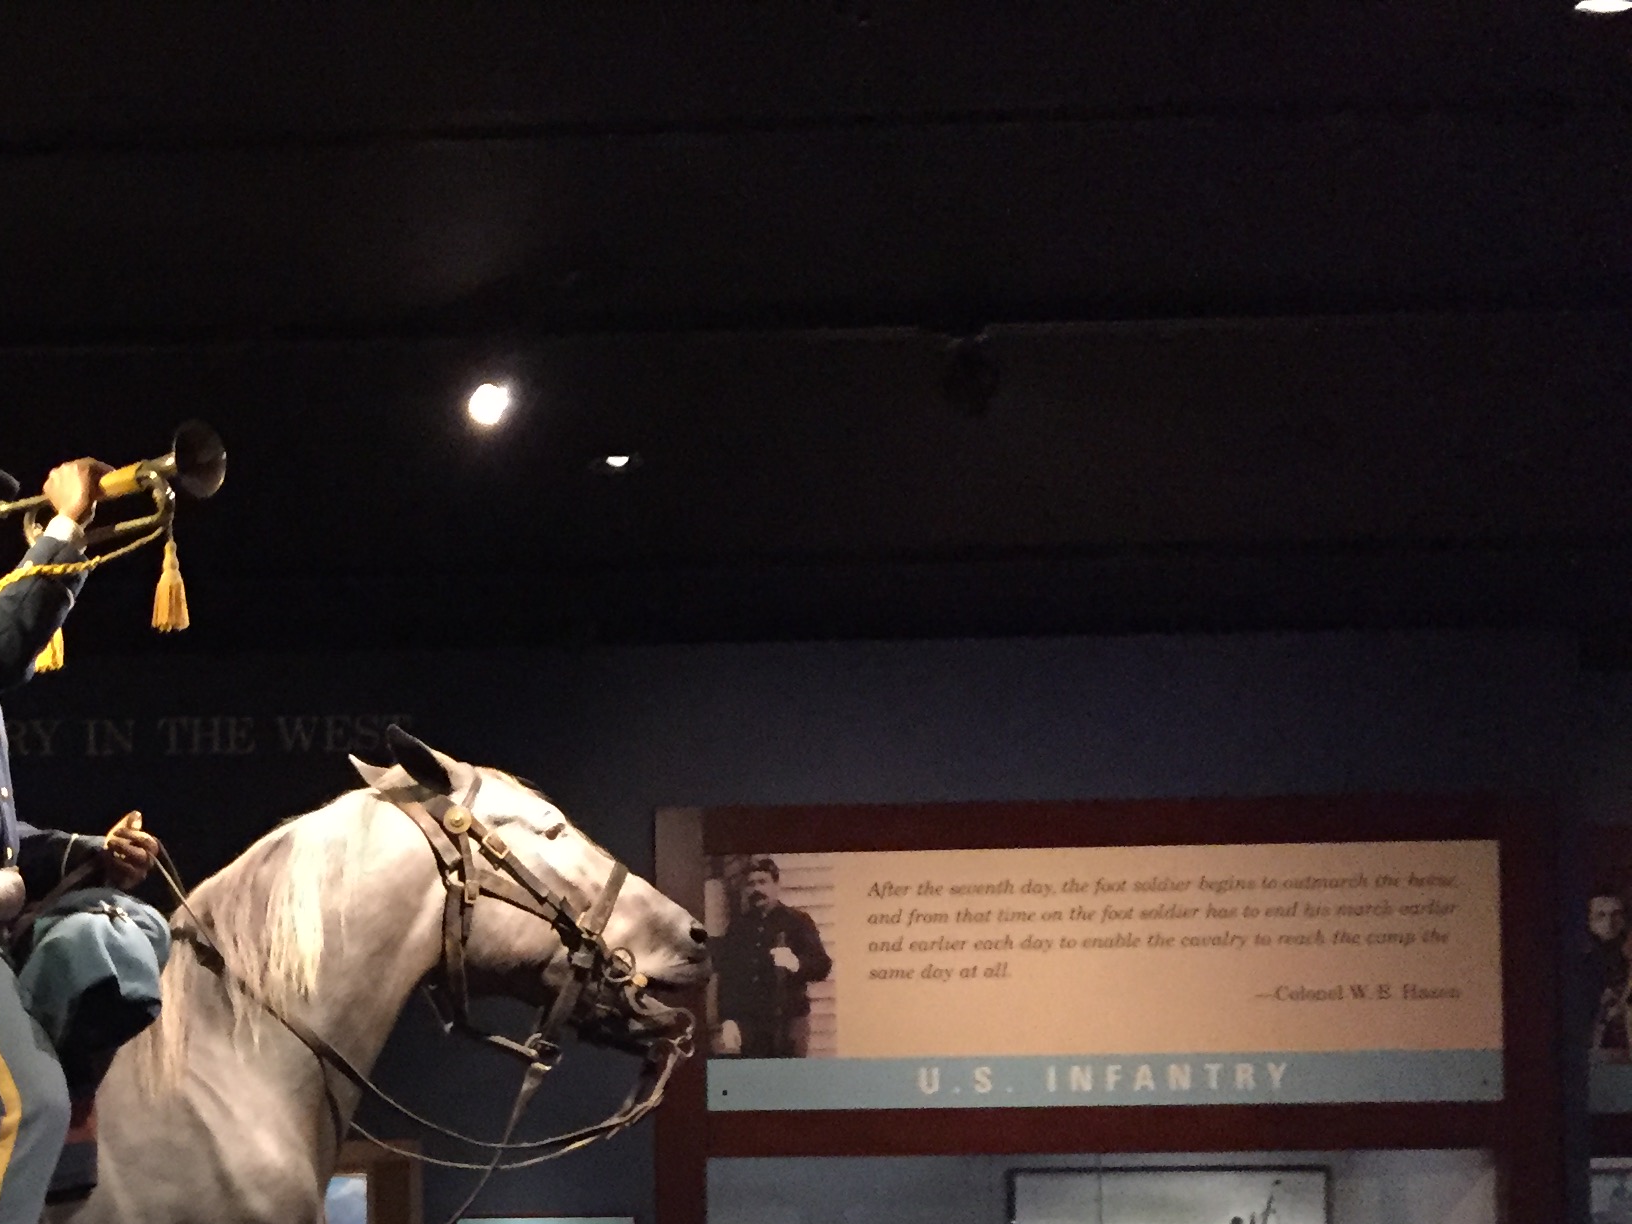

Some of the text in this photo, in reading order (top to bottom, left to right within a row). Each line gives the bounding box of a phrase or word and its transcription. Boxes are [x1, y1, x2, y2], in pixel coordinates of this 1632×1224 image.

[86, 719, 136, 757] IN
[156, 716, 257, 757] THE
[867, 882, 911, 899] After
[917, 880, 944, 897] the
[949, 879, 1015, 896] seventh
[1062, 877, 1089, 893] the
[1094, 877, 1127, 896] foot
[1133, 876, 1192, 893] soldier
[1198, 875, 1255, 894] begins
[1261, 876, 1278, 889] to
[1282, 873, 1368, 890] outmarch
[1374, 873, 1399, 887] the
[867, 899, 1459, 927] and from that time on the foot soldier has to end his march earlier
[867, 928, 1449, 952] and earlier each day to enable the cavalry to reach the camp the
[868, 965, 915, 980] same
[920, 963, 952, 982] day
[959, 964, 978, 979] at
[917, 1062, 1288, 1094] U.S. INFANTRY
